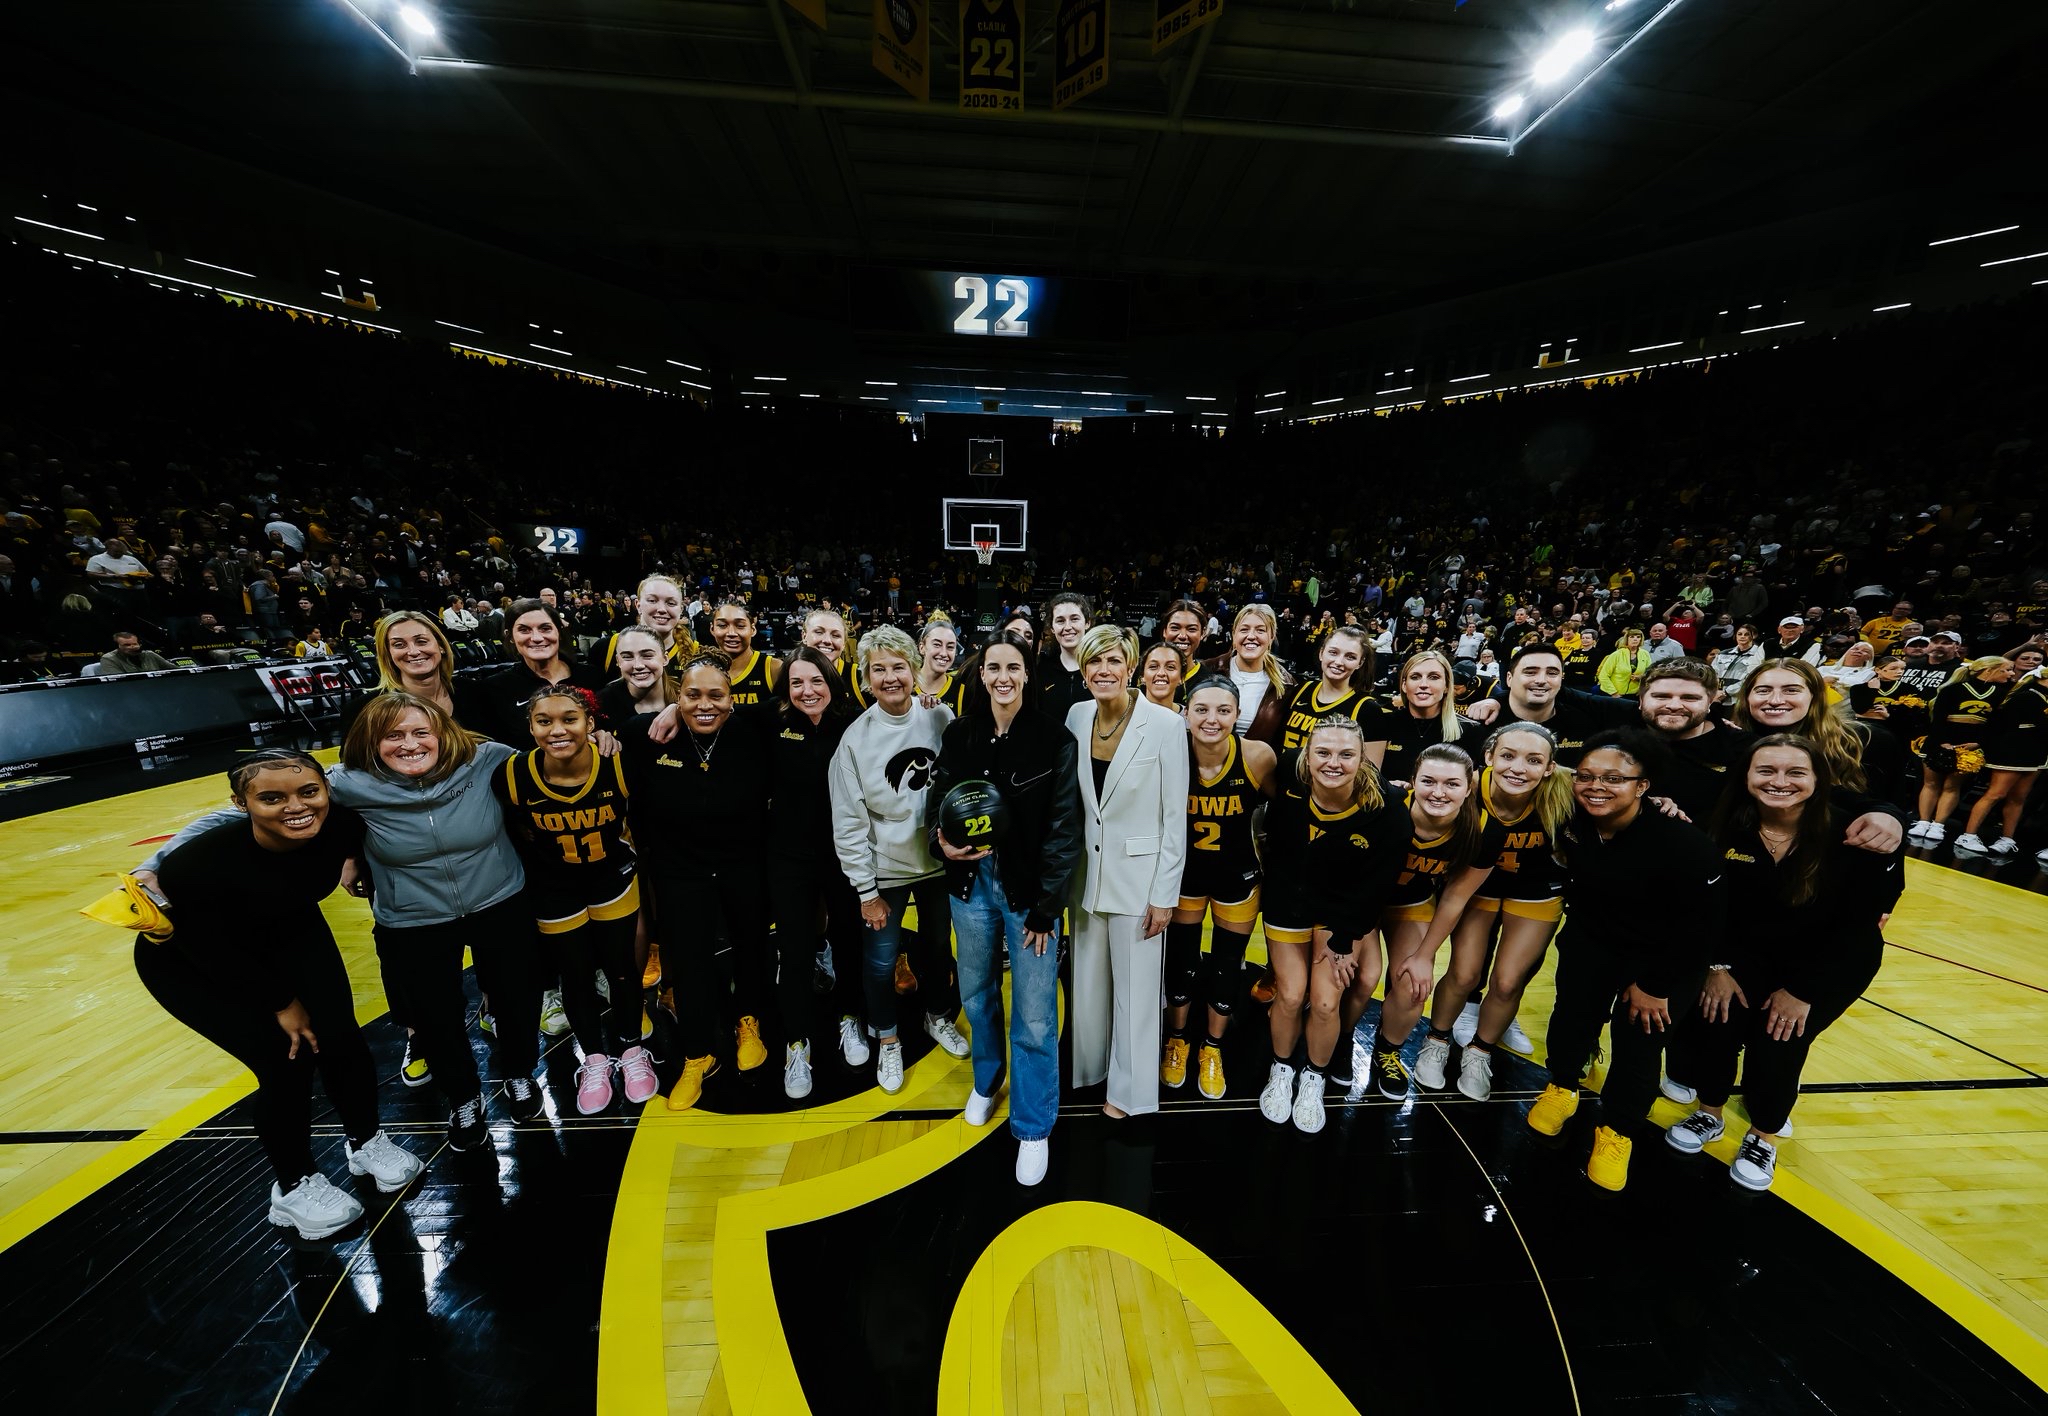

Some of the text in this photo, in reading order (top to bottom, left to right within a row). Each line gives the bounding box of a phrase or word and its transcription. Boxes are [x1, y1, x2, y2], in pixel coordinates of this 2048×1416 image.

[977, 21, 1007, 33] CLARK
[1064, 10, 1097, 69] 10
[970, 37, 1014, 79] 22
[963, 94, 1020, 109] 2020-24
[953, 276, 1029, 336] 22
[534, 526, 579, 555] 22
[1286, 710, 1321, 735] IOW
[531, 804, 616, 832] IOWA
[1187, 794, 1244, 816] OWA
[964, 814, 993, 836] 22
[1193, 821, 1221, 851] 2
[556, 830, 607, 864] 11
